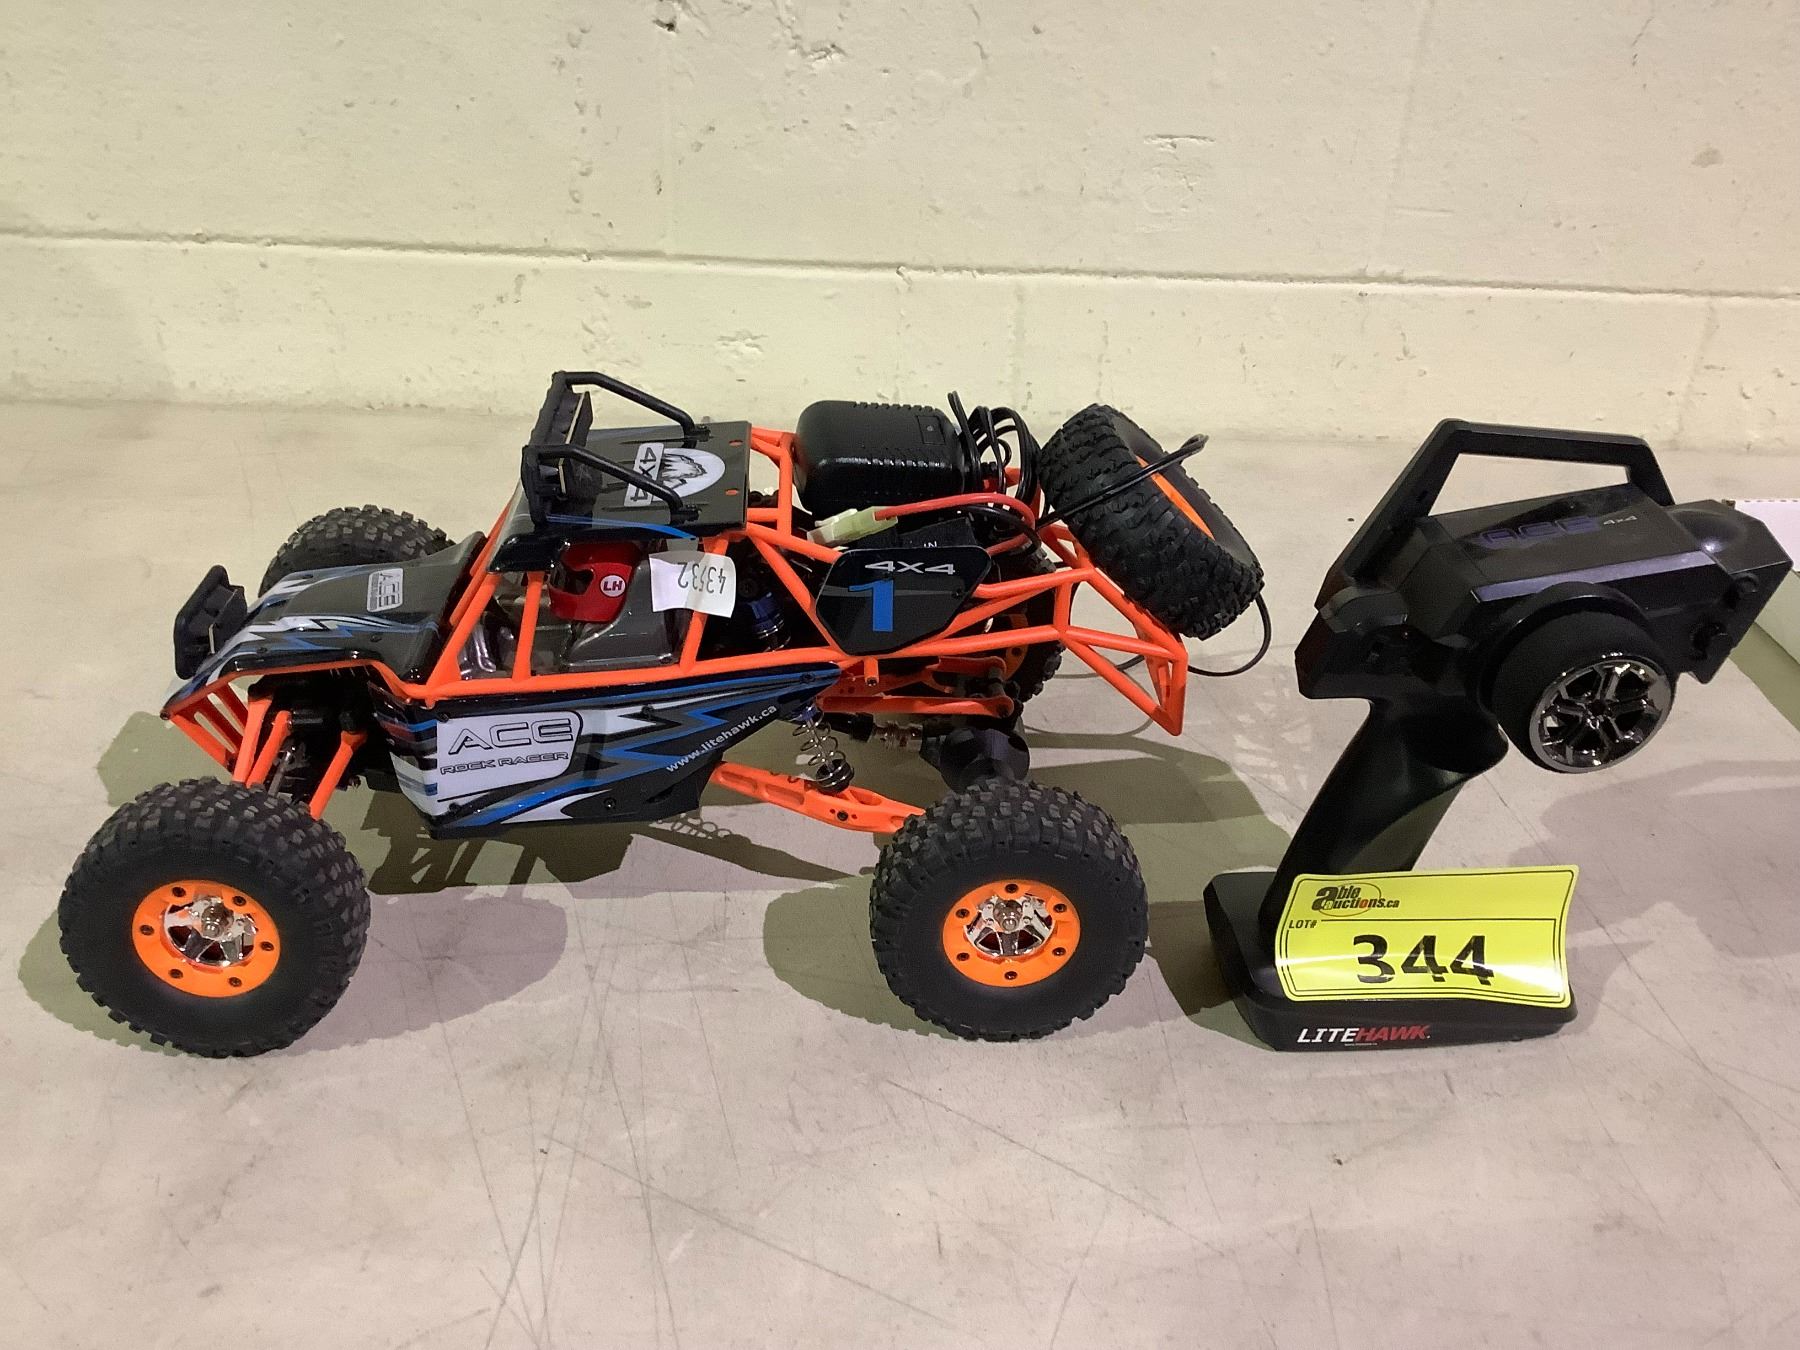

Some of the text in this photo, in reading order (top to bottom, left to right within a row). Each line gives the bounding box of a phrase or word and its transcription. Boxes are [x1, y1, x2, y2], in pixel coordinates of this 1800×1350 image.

[603, 580, 623, 592] LH
[848, 579, 894, 632] 1
[448, 718, 574, 755] ACE
[665, 704, 778, 773] www.litehawk.ca
[440, 752, 569, 775] ROCK RACER
[1311, 885, 1361, 911] able
[1288, 919, 1317, 929] LOT#
[1353, 934, 1495, 986] 344
